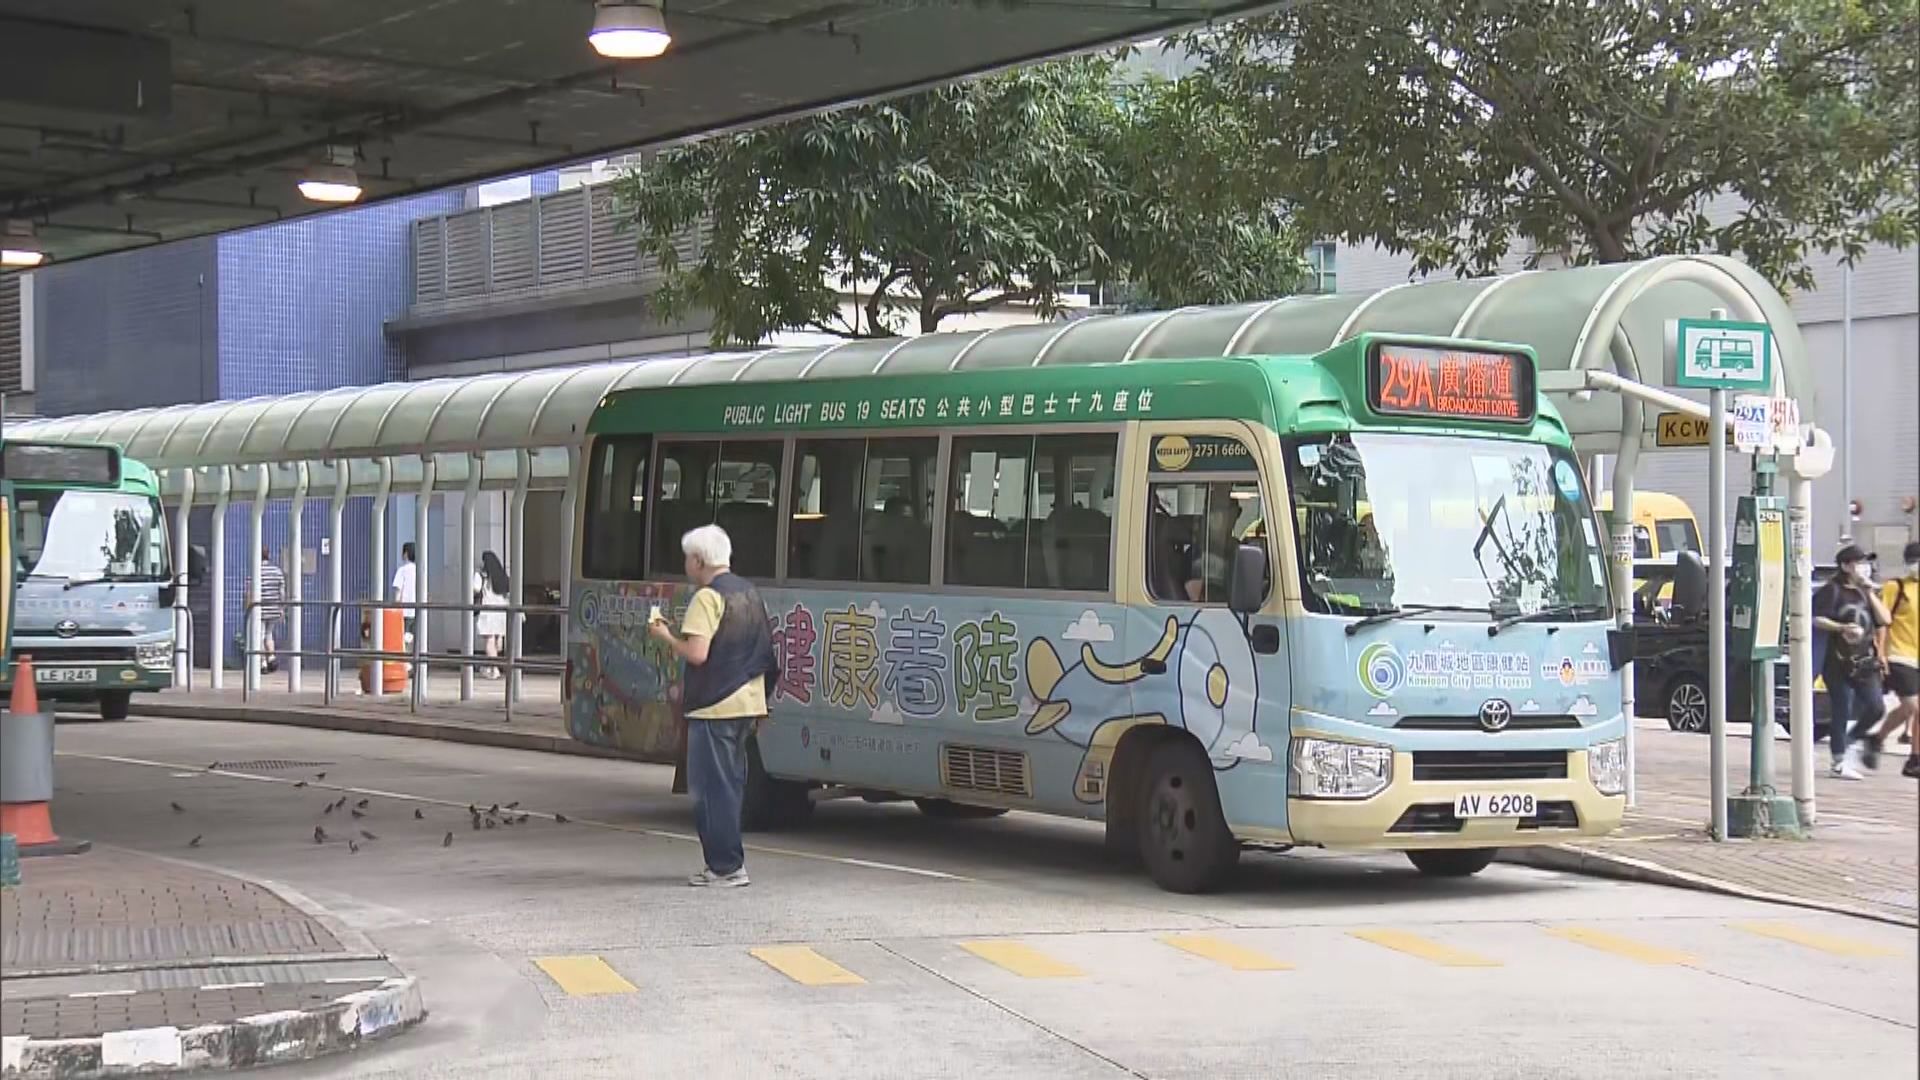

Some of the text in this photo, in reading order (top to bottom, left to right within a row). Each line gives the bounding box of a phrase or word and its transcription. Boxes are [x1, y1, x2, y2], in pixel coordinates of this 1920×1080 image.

[1380, 354, 1435, 408] 29A
[1437, 355, 1513, 398] 廣播道
[723, 397, 927, 425] PUBLIC LIGHT BUS 19 SEATS
[936, 388, 1154, 417] 公共小型巴士十九座位
[1437, 396, 1520, 417] BROADCAST DRIVE
[1194, 443, 1219, 457] 2751
[1221, 443, 1247, 456] 6666
[767, 603, 1020, 722] 健康着陸
[41, 670, 93, 681] LE 1245
[1407, 673, 1447, 687] Kowloon
[1452, 674, 1472, 690] City
[1497, 674, 1531, 689] Express
[1459, 794, 1534, 813] AV 6208
